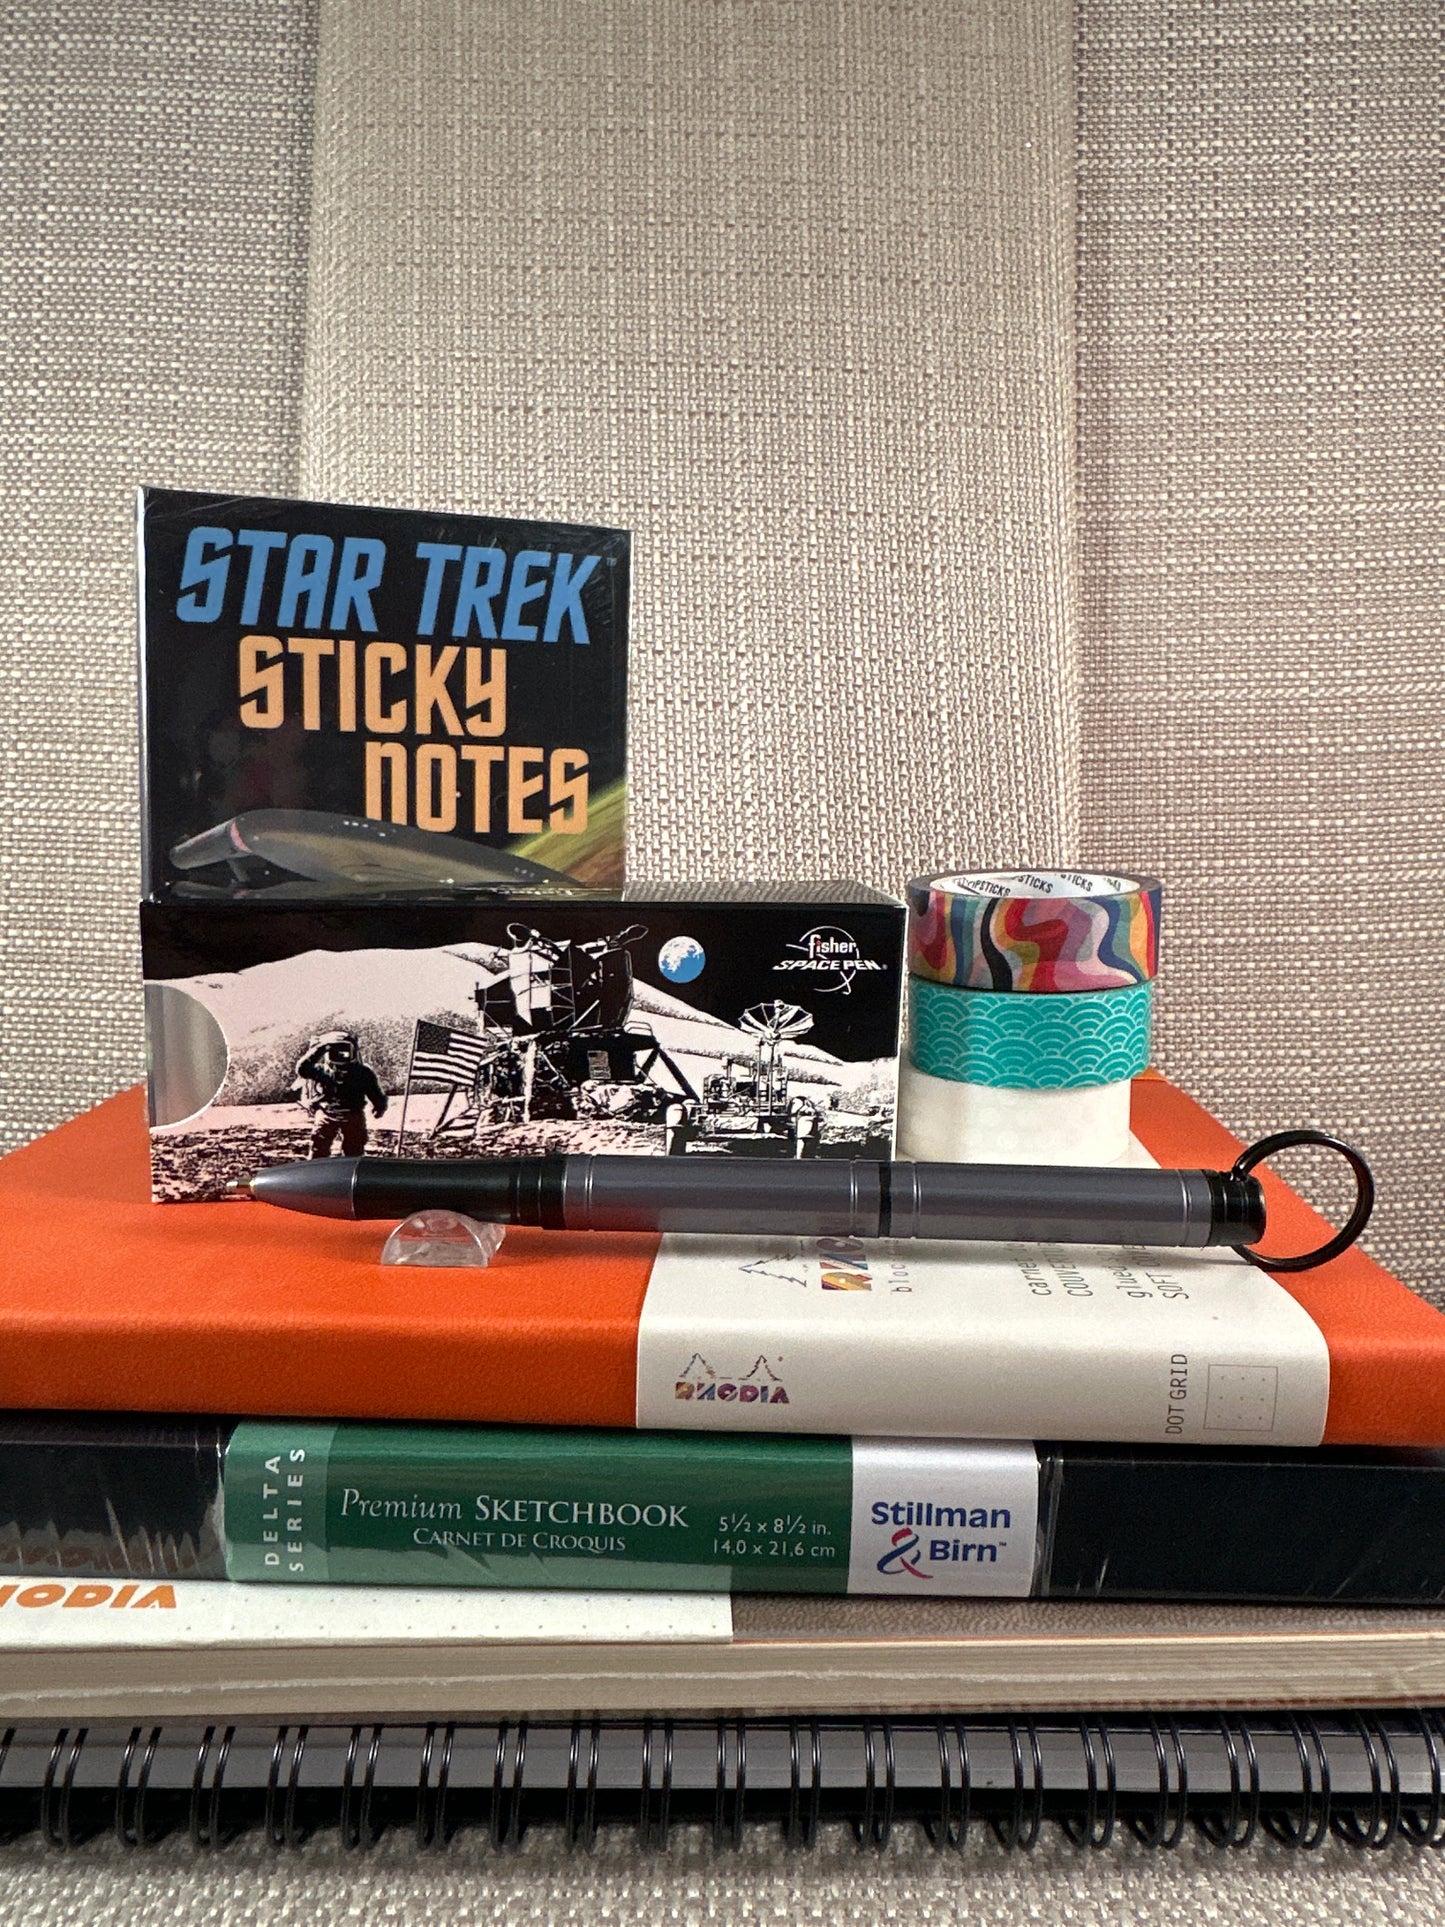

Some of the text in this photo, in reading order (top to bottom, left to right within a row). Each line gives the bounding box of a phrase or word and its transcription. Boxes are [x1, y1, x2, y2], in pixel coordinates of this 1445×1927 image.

[176, 526, 387, 632] STAR
[238, 635, 507, 738] STICKY
[365, 741, 590, 835] NOTES
[808, 934, 857, 959] fisher
[772, 960, 841, 970] SPACE
[1145, 1271, 1189, 1299] SOFT
[675, 1381, 790, 1404] RHODIA
[1164, 1354, 1188, 1435] DOT GRID
[263, 1456, 280, 1565] DELTA
[287, 1449, 305, 1571] SERIES
[340, 1488, 689, 1528] Premium SKETCHBOOK
[871, 1501, 1011, 1528] Stillman
[413, 1528, 627, 1553] CARNET DE CROQUIS
[810, 1545, 836, 1557] cm
